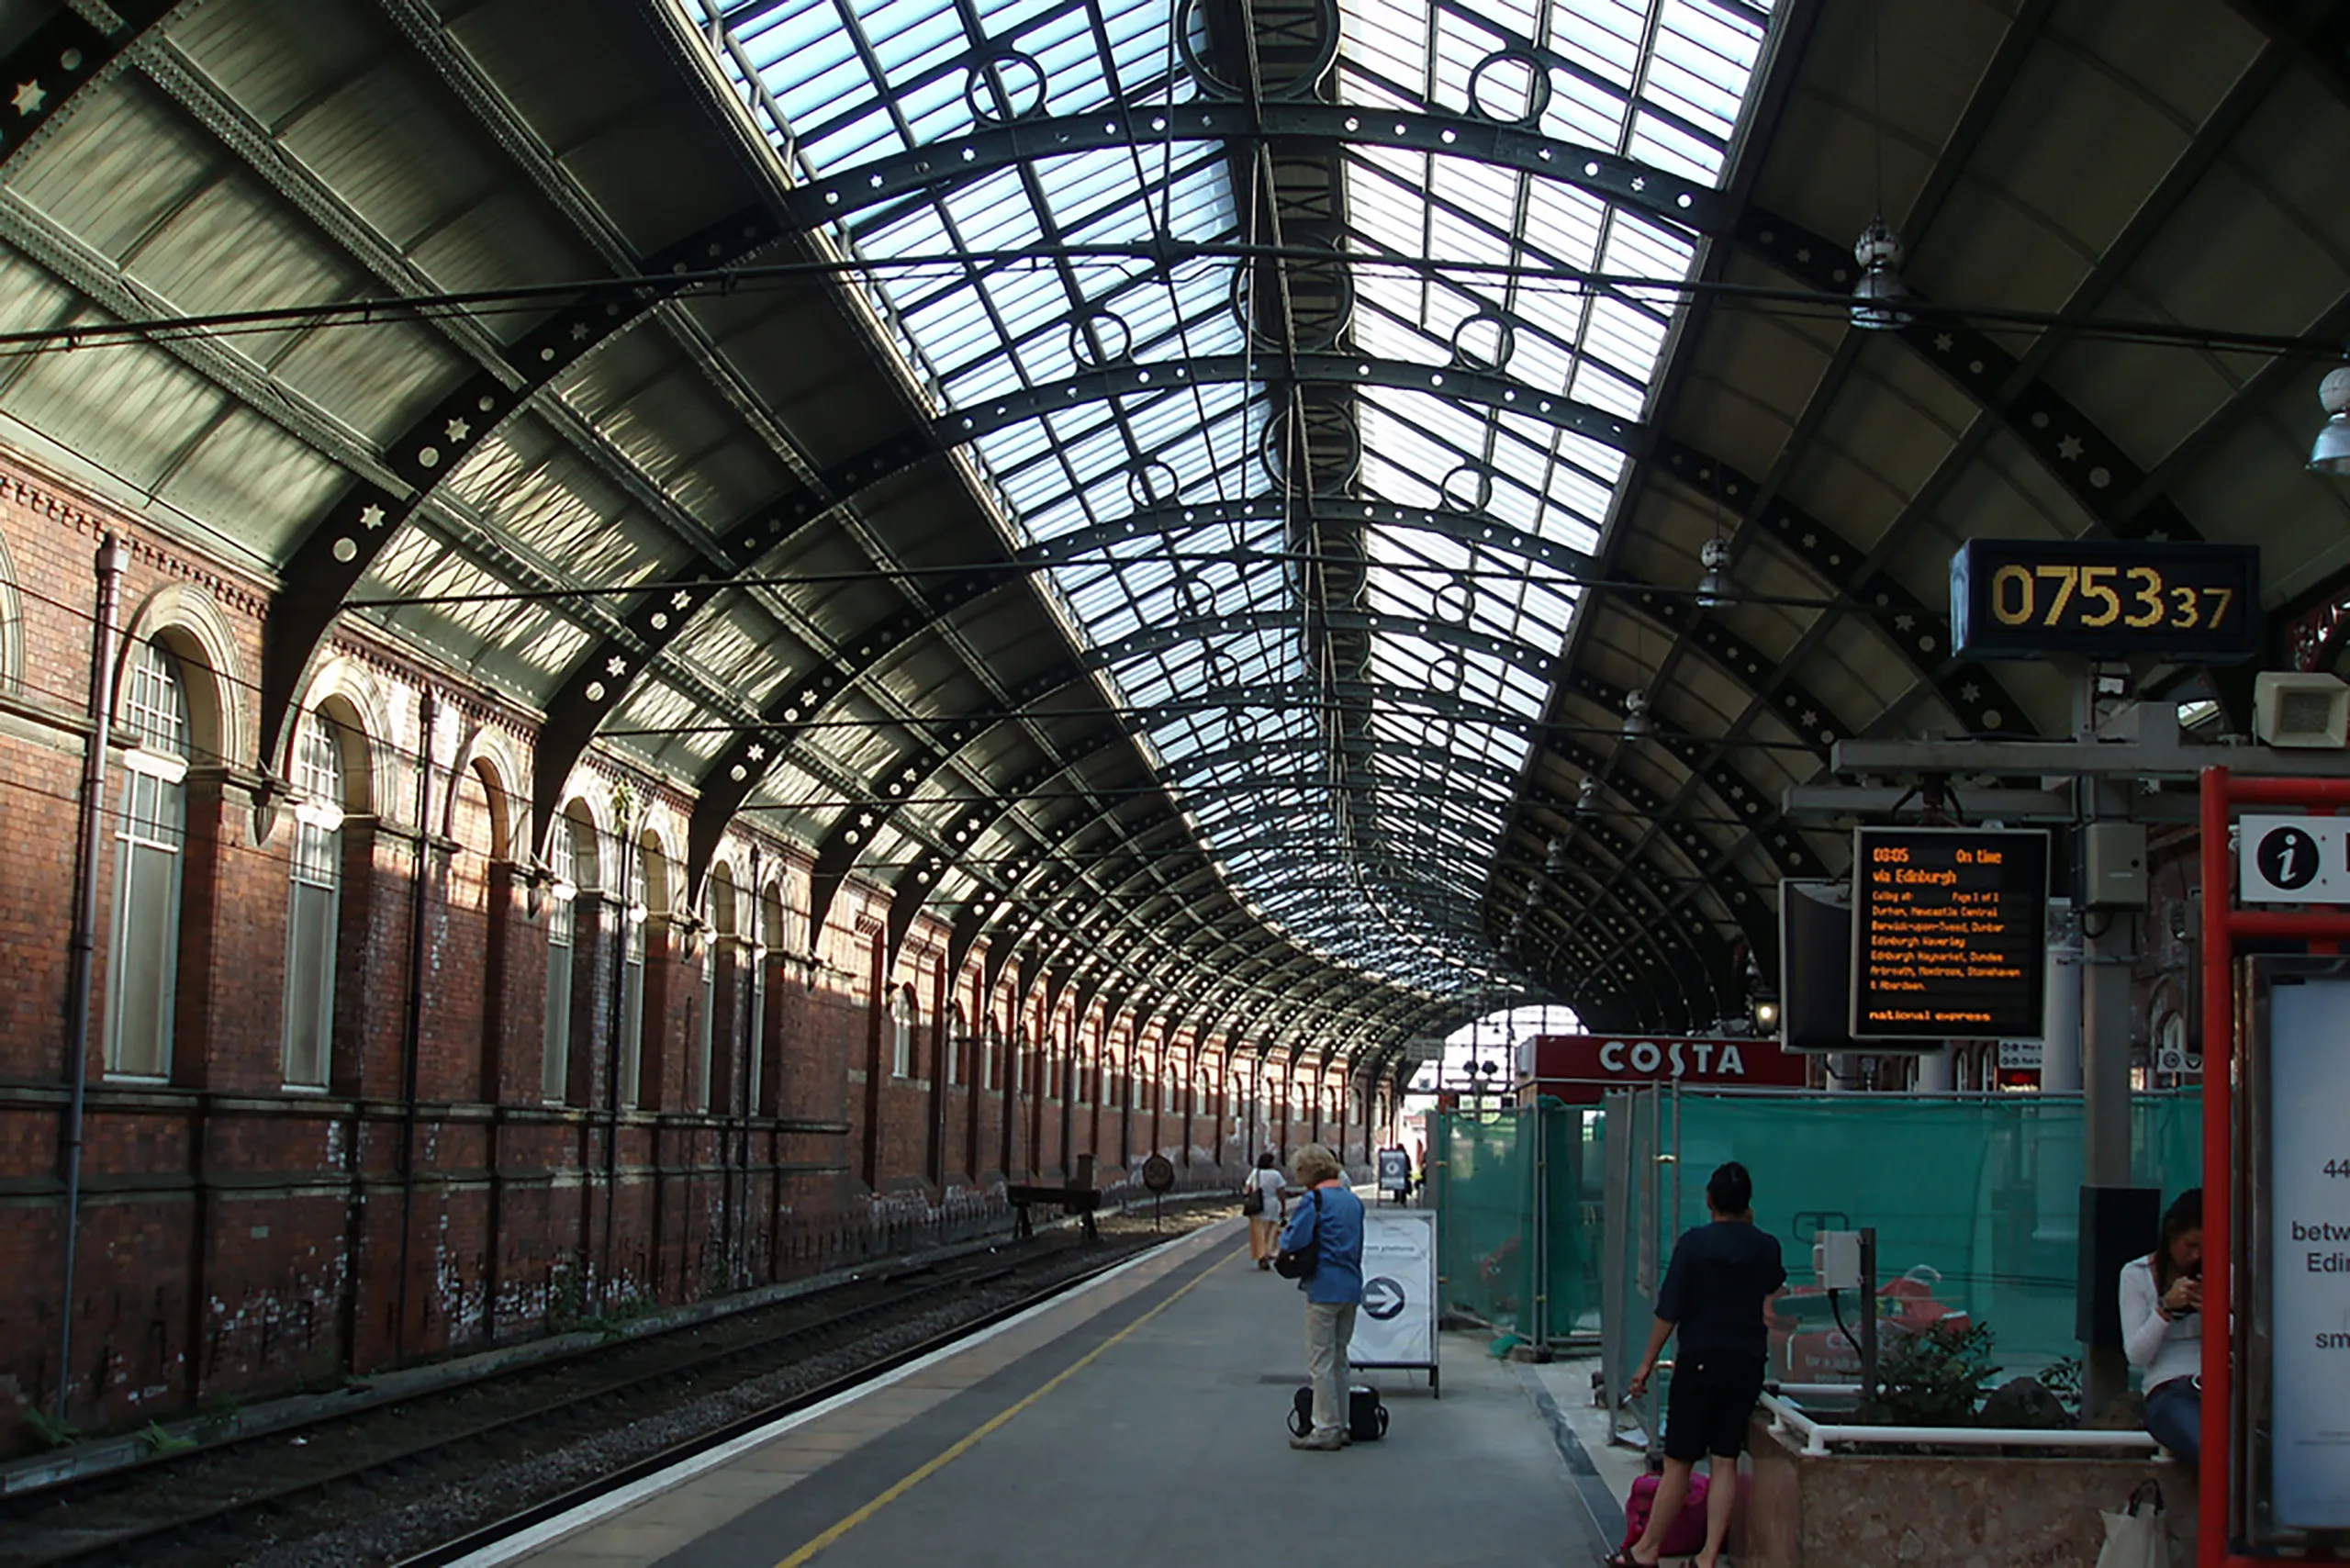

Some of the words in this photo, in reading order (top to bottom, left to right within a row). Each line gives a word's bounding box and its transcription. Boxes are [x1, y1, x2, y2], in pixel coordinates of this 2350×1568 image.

[1992, 565, 2165, 627] 0753
[2171, 588, 2232, 629] 37
[1955, 849, 1973, 863] On
[1976, 849, 2002, 864] time
[1873, 868, 1891, 883] via
[1896, 868, 1957, 886] Edinburgh
[1981, 892, 1991, 902] of
[1910, 906, 1958, 916] Newcastle
[1871, 935, 1919, 948] Edinburgh
[1870, 949, 1915, 963] Edinburgh
[1869, 1010, 1930, 1021] national
[1935, 1012, 1991, 1022] express
[1599, 1040, 1744, 1077] COSTA
